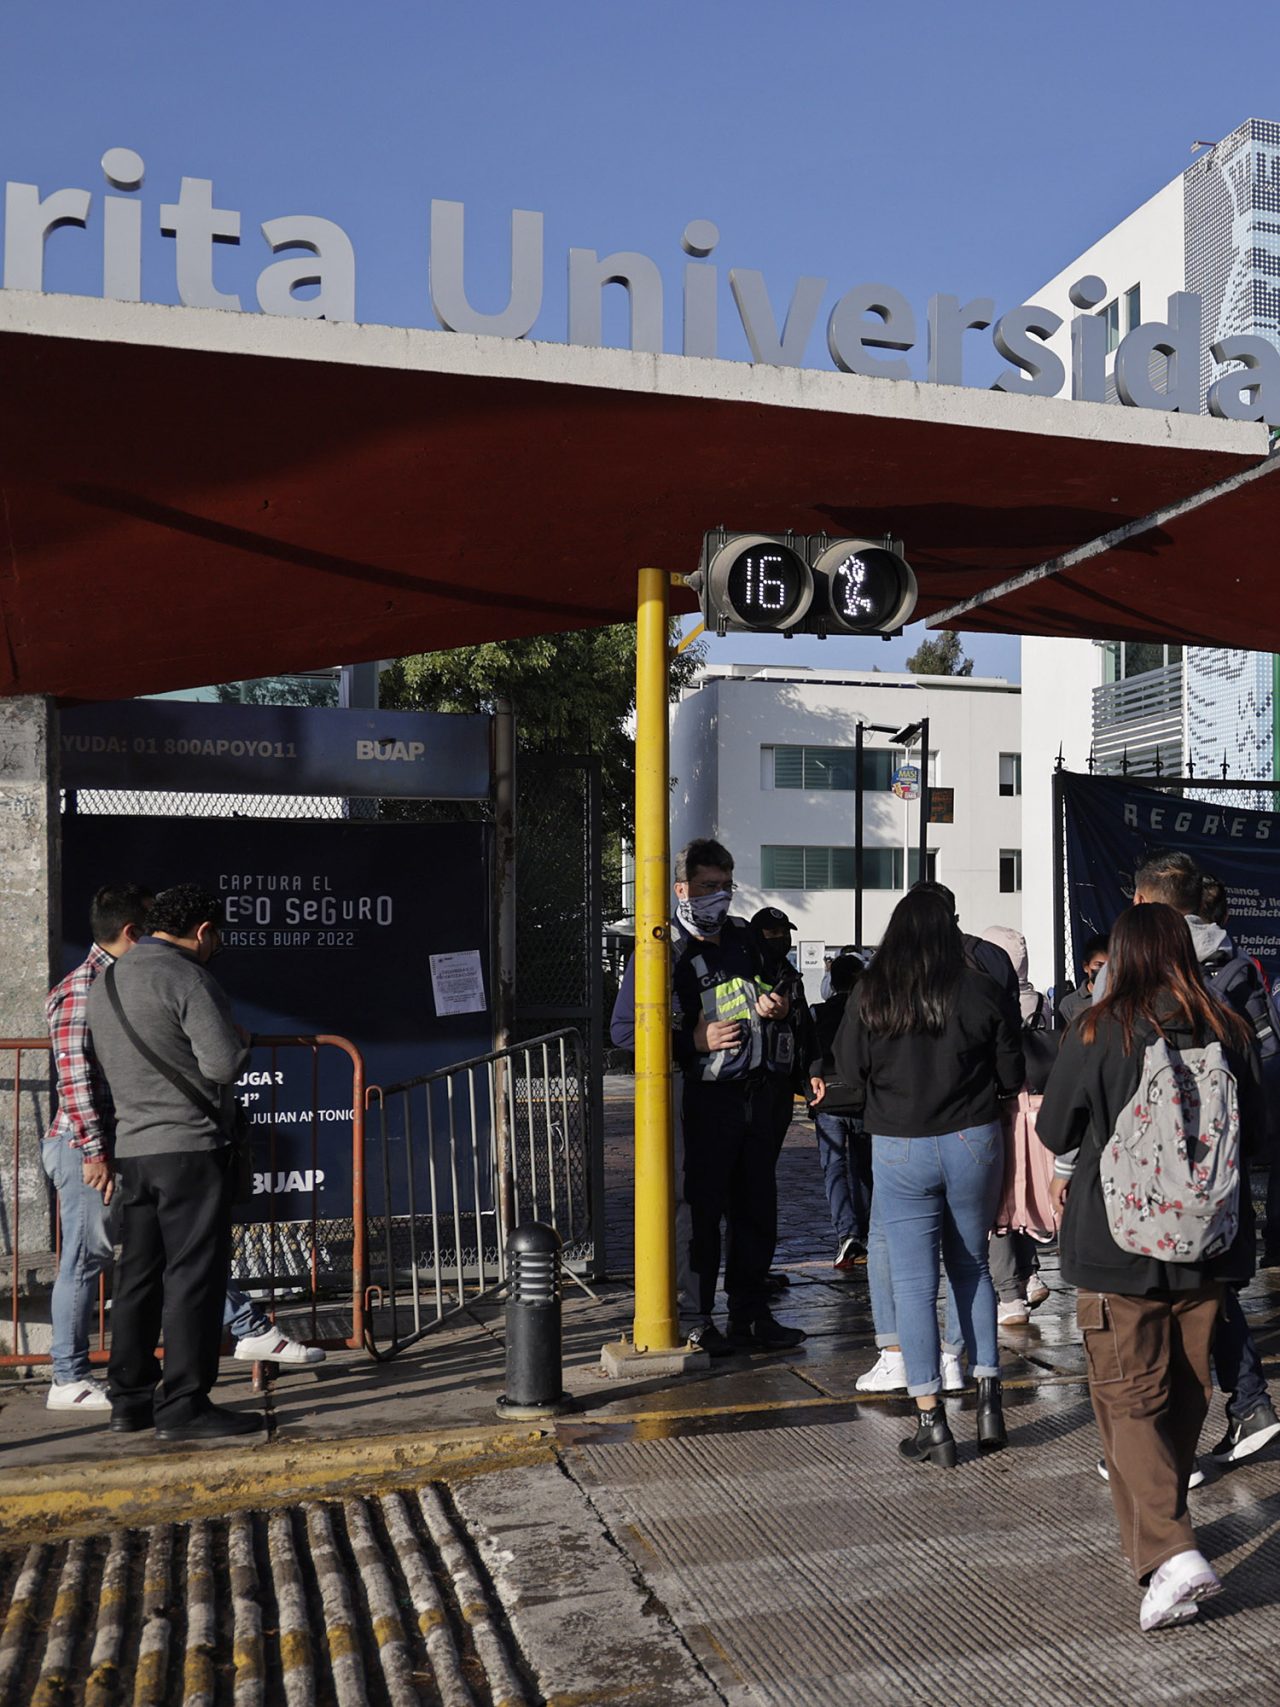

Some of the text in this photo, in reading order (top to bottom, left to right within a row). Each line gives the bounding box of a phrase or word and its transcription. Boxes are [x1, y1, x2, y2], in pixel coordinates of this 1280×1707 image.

[3, 147, 356, 321] rita
[744, 555, 786, 609] 16
[133, 736, 157, 755] 01
[219, 874, 333, 891] CAPTURA EL
[223, 895, 271, 926] ESO
[1259, 898, 1267, 908] y
[273, 931, 311, 946] BUAP
[317, 931, 354, 946] 2022
[234, 1071, 284, 1086] UGAR
[250, 1111, 297, 1125] JULIAN
